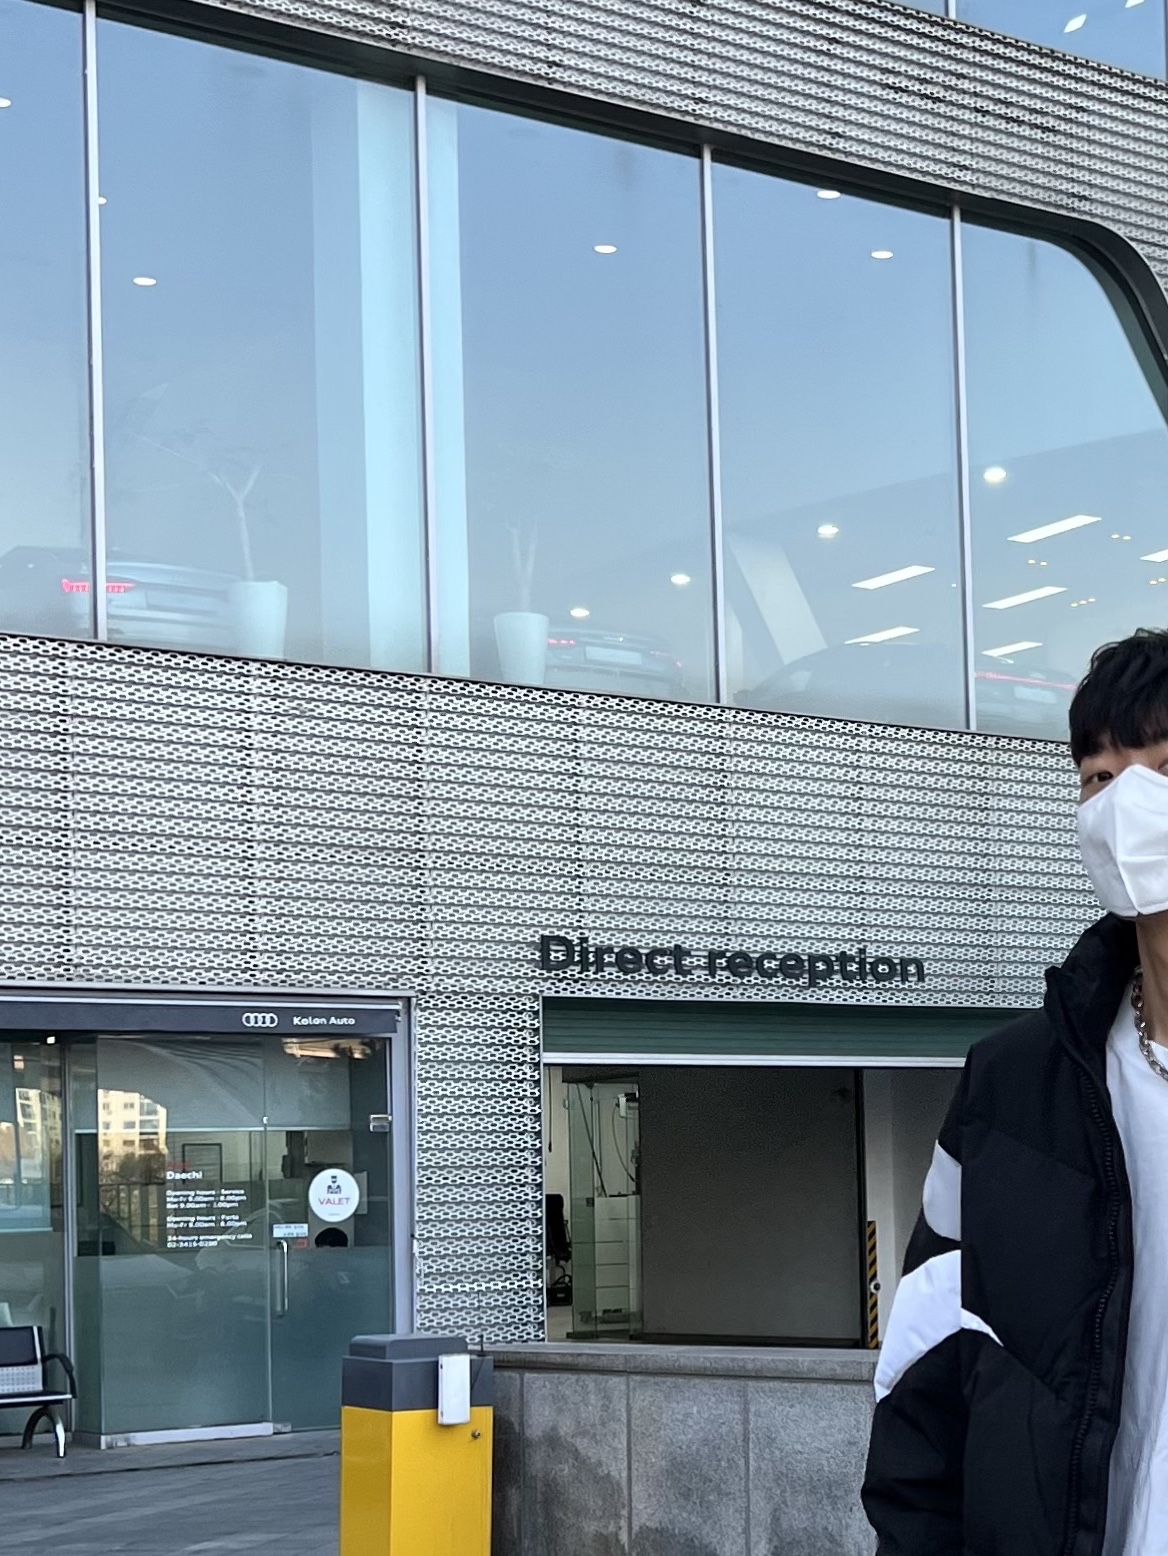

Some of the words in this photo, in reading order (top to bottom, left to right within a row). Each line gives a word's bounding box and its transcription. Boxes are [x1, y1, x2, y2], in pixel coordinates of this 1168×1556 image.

[540, 934, 692, 976] Direct
[708, 947, 925, 989] reception
[293, 1016, 327, 1026] Kolon
[329, 1016, 356, 1025] Auto
[318, 1197, 351, 1206] VALET
